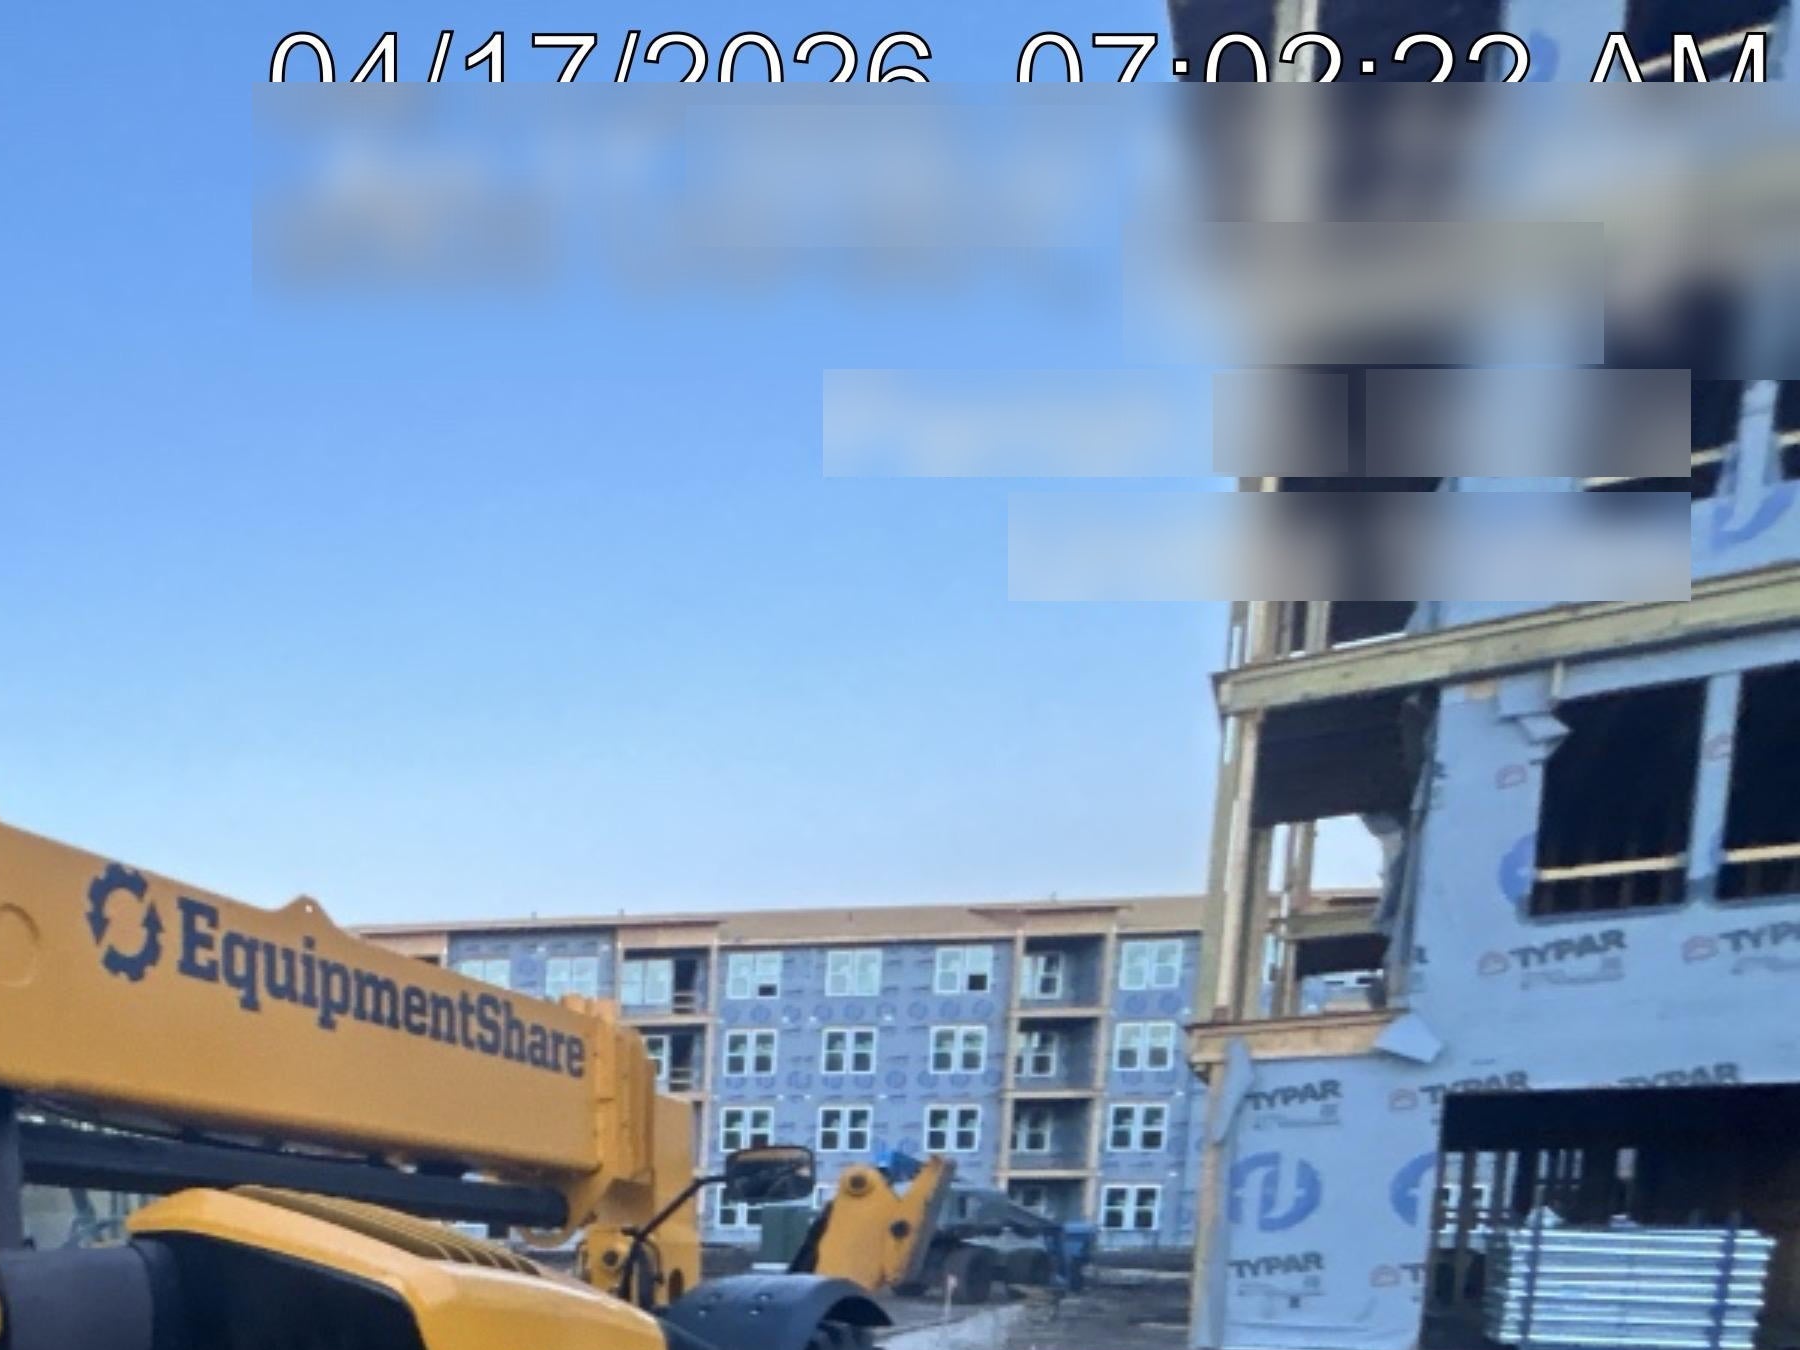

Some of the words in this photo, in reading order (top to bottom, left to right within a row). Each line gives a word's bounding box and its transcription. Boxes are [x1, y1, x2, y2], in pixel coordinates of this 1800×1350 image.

[1508, 928, 1628, 968] TYPAR
[177, 896, 585, 1078] EquipmentShare
[1244, 1079, 1342, 1111] TYPAR
[1228, 1251, 1325, 1279] TYPAR
